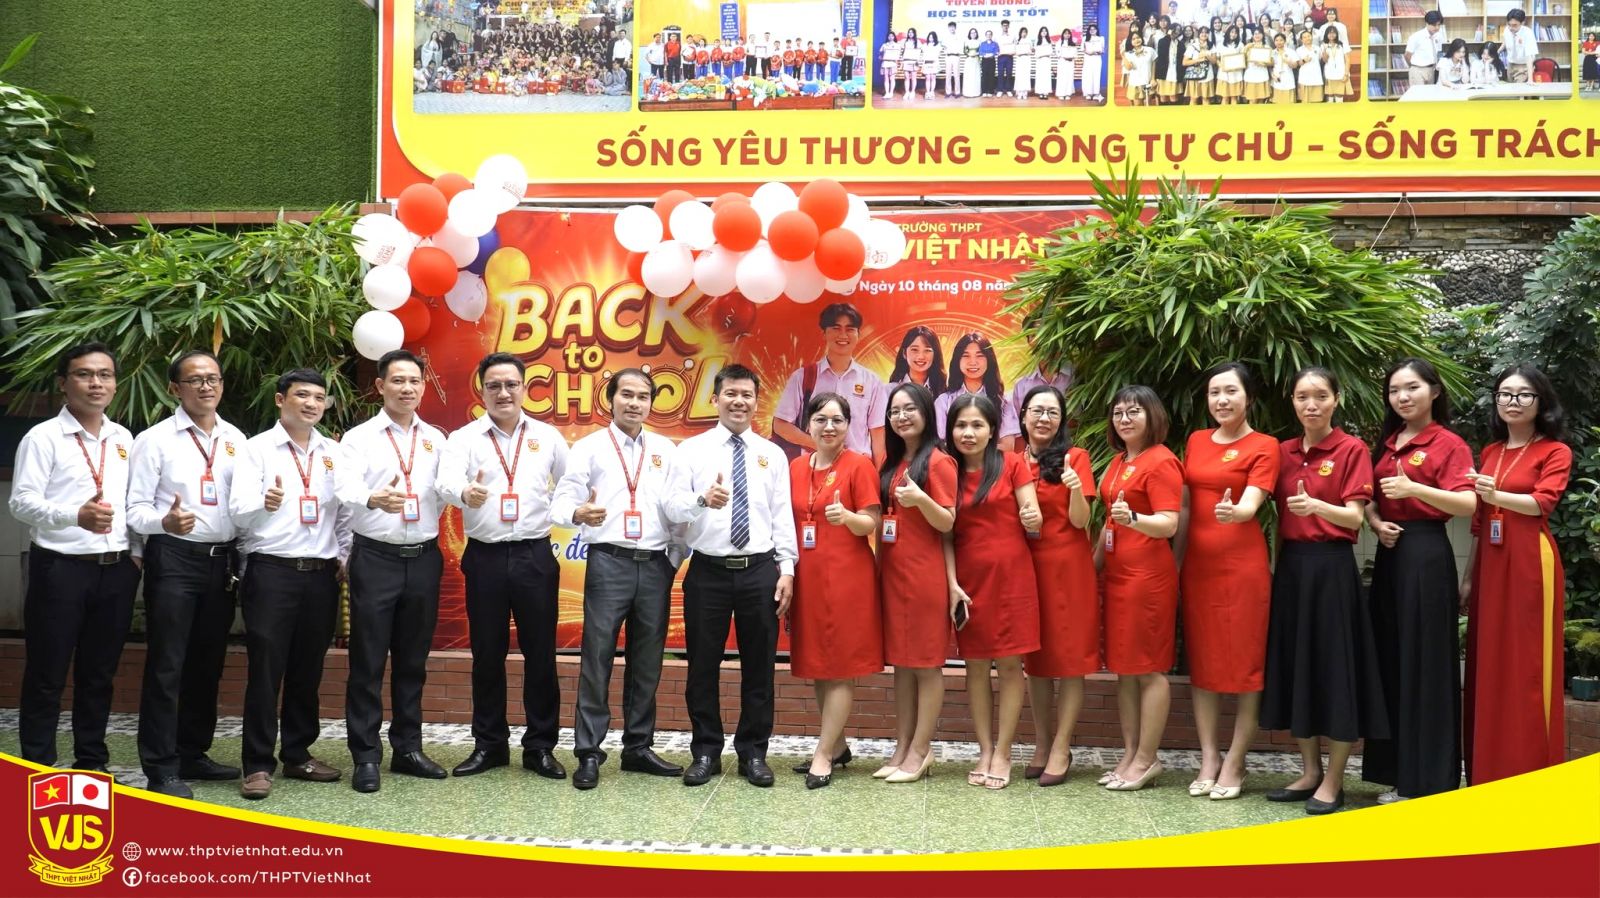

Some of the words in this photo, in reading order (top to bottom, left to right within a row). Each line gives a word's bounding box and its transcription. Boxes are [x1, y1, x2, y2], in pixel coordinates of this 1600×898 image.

[962, 9, 998, 18] SINH
[1002, 9, 1012, 17] 3
[597, 125, 701, 167] SỐNG
[712, 130, 788, 166] YÊU
[800, 135, 972, 165] THƯƠNG
[1014, 121, 1127, 165] SỐNG
[1138, 133, 1196, 169] TỰ
[1208, 121, 1293, 162] CHỦ
[1338, 115, 1458, 160] SỐNG
[1470, 120, 1600, 159] TRÁCH
[950, 222, 982, 232] THPT
[902, 233, 961, 266] VIỆT
[968, 232, 1051, 265] NHẬT
[860, 280, 895, 295] Ngày
[899, 280, 914, 291] 10
[918, 280, 958, 294] tháng
[962, 280, 982, 291] 08
[497, 280, 702, 354] BACK
[563, 341, 605, 370] to
[469, 357, 725, 421] CHOL
